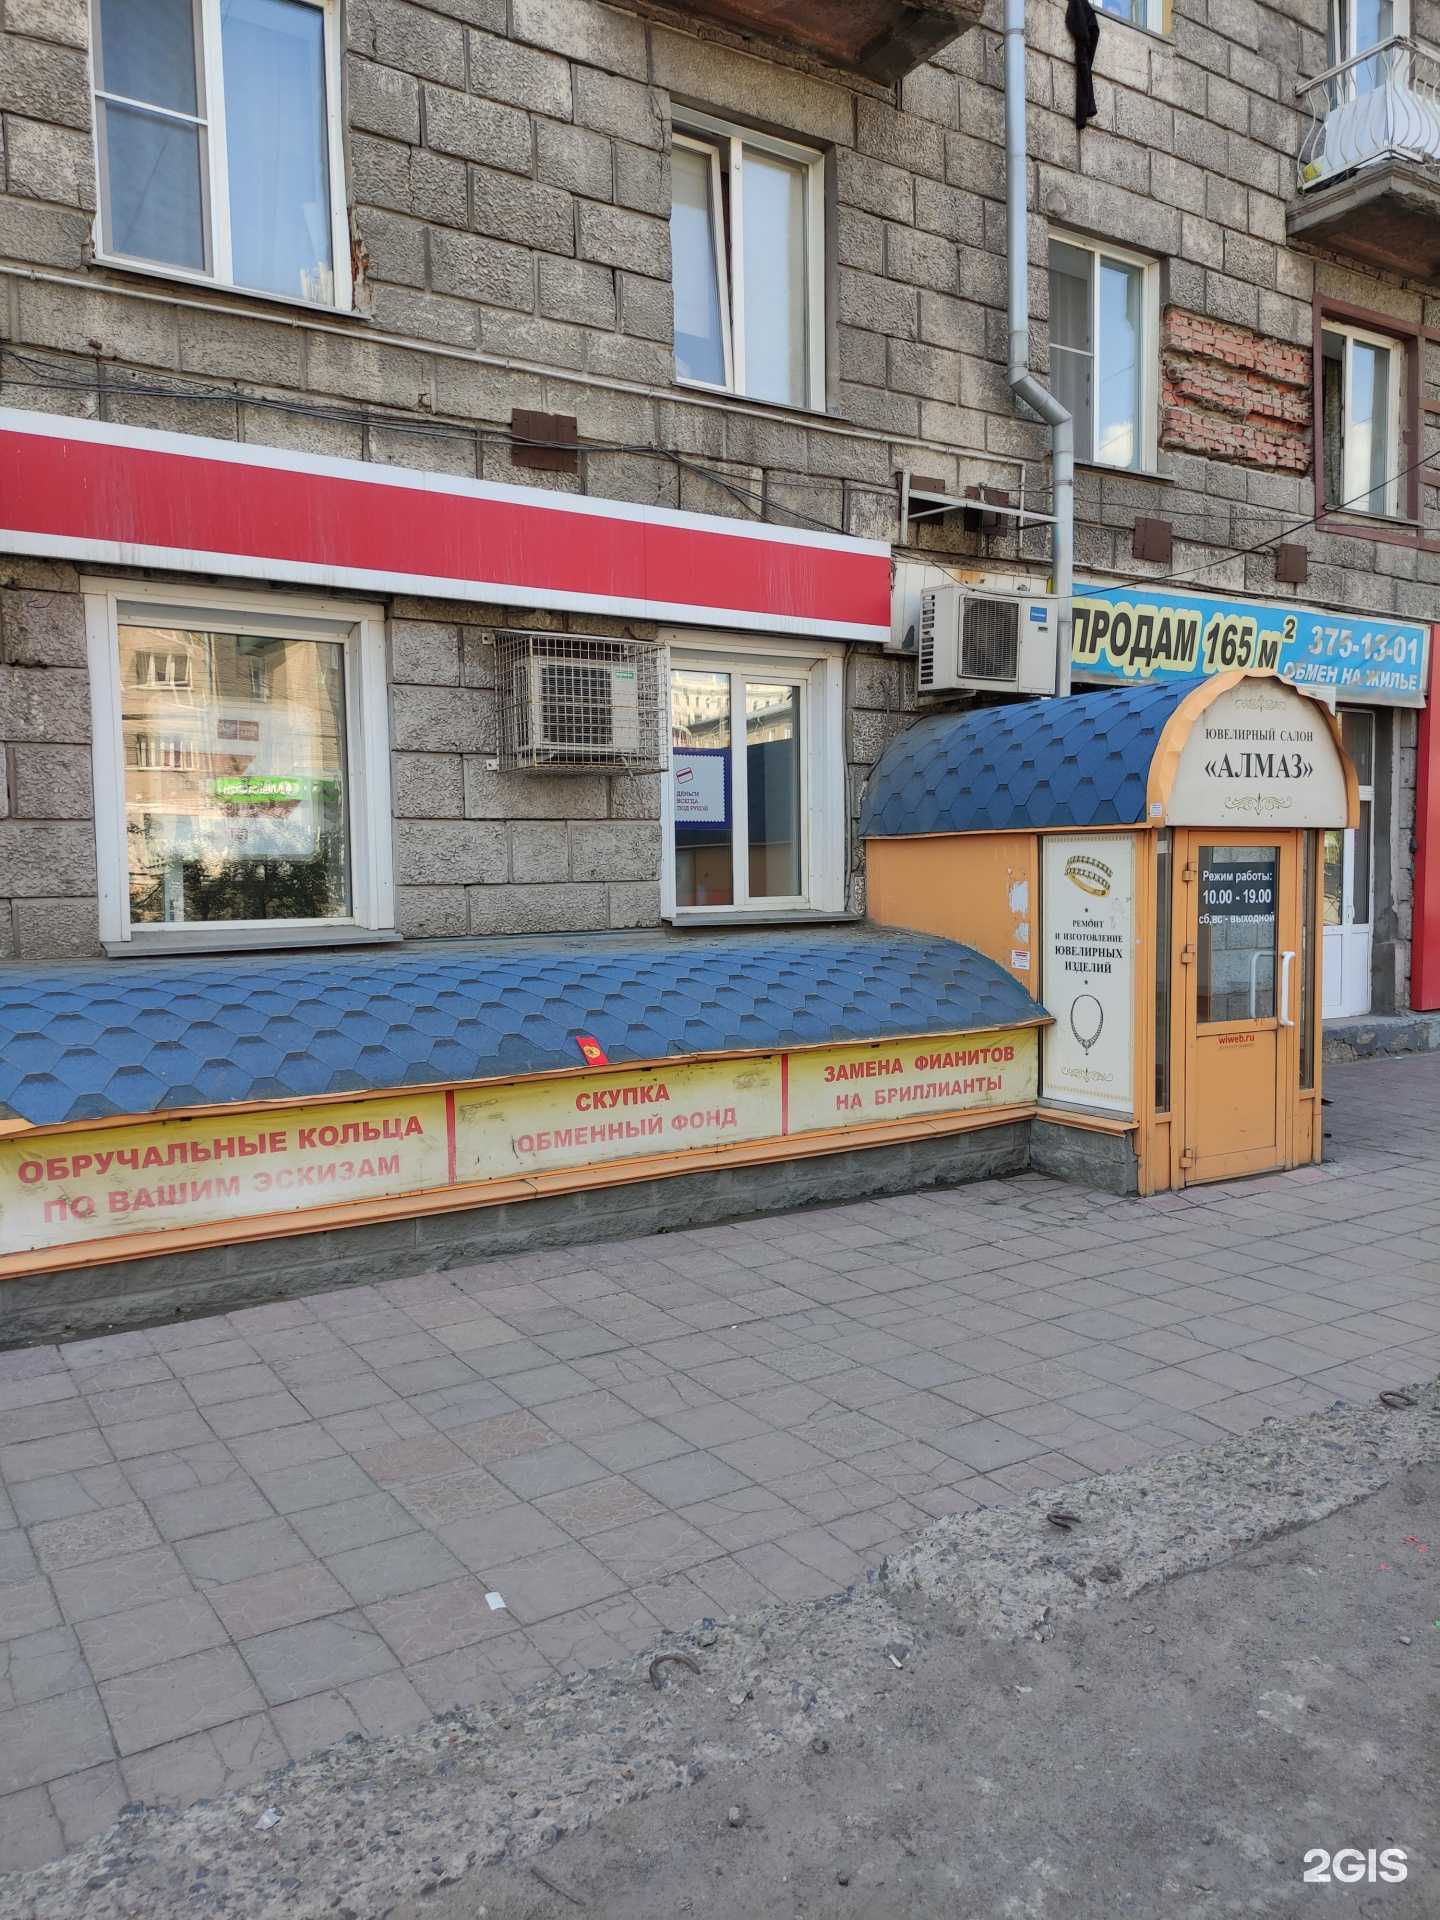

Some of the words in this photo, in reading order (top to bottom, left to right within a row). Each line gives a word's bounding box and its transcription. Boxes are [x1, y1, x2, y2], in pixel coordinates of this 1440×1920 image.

[1072, 607, 1197, 667] ПРОДАМ
[1207, 622, 1253, 667] 165
[1308, 625, 1418, 665] 375-13-01
[1284, 662, 1338, 683] ОБМЕН
[1341, 668, 1361, 685] НА
[1366, 670, 1418, 690] ЖИЛЬЕ
[1205, 728, 1275, 741] ЮВЕЛИРНЫЙ
[1280, 730, 1313, 742] САЛОН
[1204, 752, 1314, 778] «АЛМАЗ»
[1203, 870, 1233, 881] Режим
[1236, 870, 1272, 884] работы:
[1203, 889, 1232, 904] 10.00
[1243, 889, 1272, 904] 19.00
[1072, 919, 1104, 928] РЕМОНТ
[1199, 913, 1223, 925] сб,вс
[1230, 911, 1275, 924] выходной
[1063, 932, 1124, 942] ИЗГОТОВЛЕНИЕ
[1055, 946, 1123, 958] ЮВЕЛИРНЫХ
[1065, 961, 1112, 973] ИЗДЕЛИЙ
[824, 1058, 903, 1083] ЗАМЕНА
[914, 1046, 1014, 1071] ФИАНИТОВ
[575, 1084, 670, 1112] СКУПКА
[836, 1092, 862, 1110] НА
[875, 1075, 1002, 1105] БРИЛЛИАНТЫ
[516, 1113, 663, 1152] ОБМЕННЫЙ
[671, 1107, 737, 1130] ФОНД
[18, 1130, 288, 1185] ОБРУЧАЛЬНЫЕ
[300, 1115, 424, 1150] КОЛЬЦА
[43, 1195, 96, 1223] ПО
[107, 1175, 240, 1213] ВАШИМ
[252, 1155, 401, 1193] ЭСКИЗАМ
